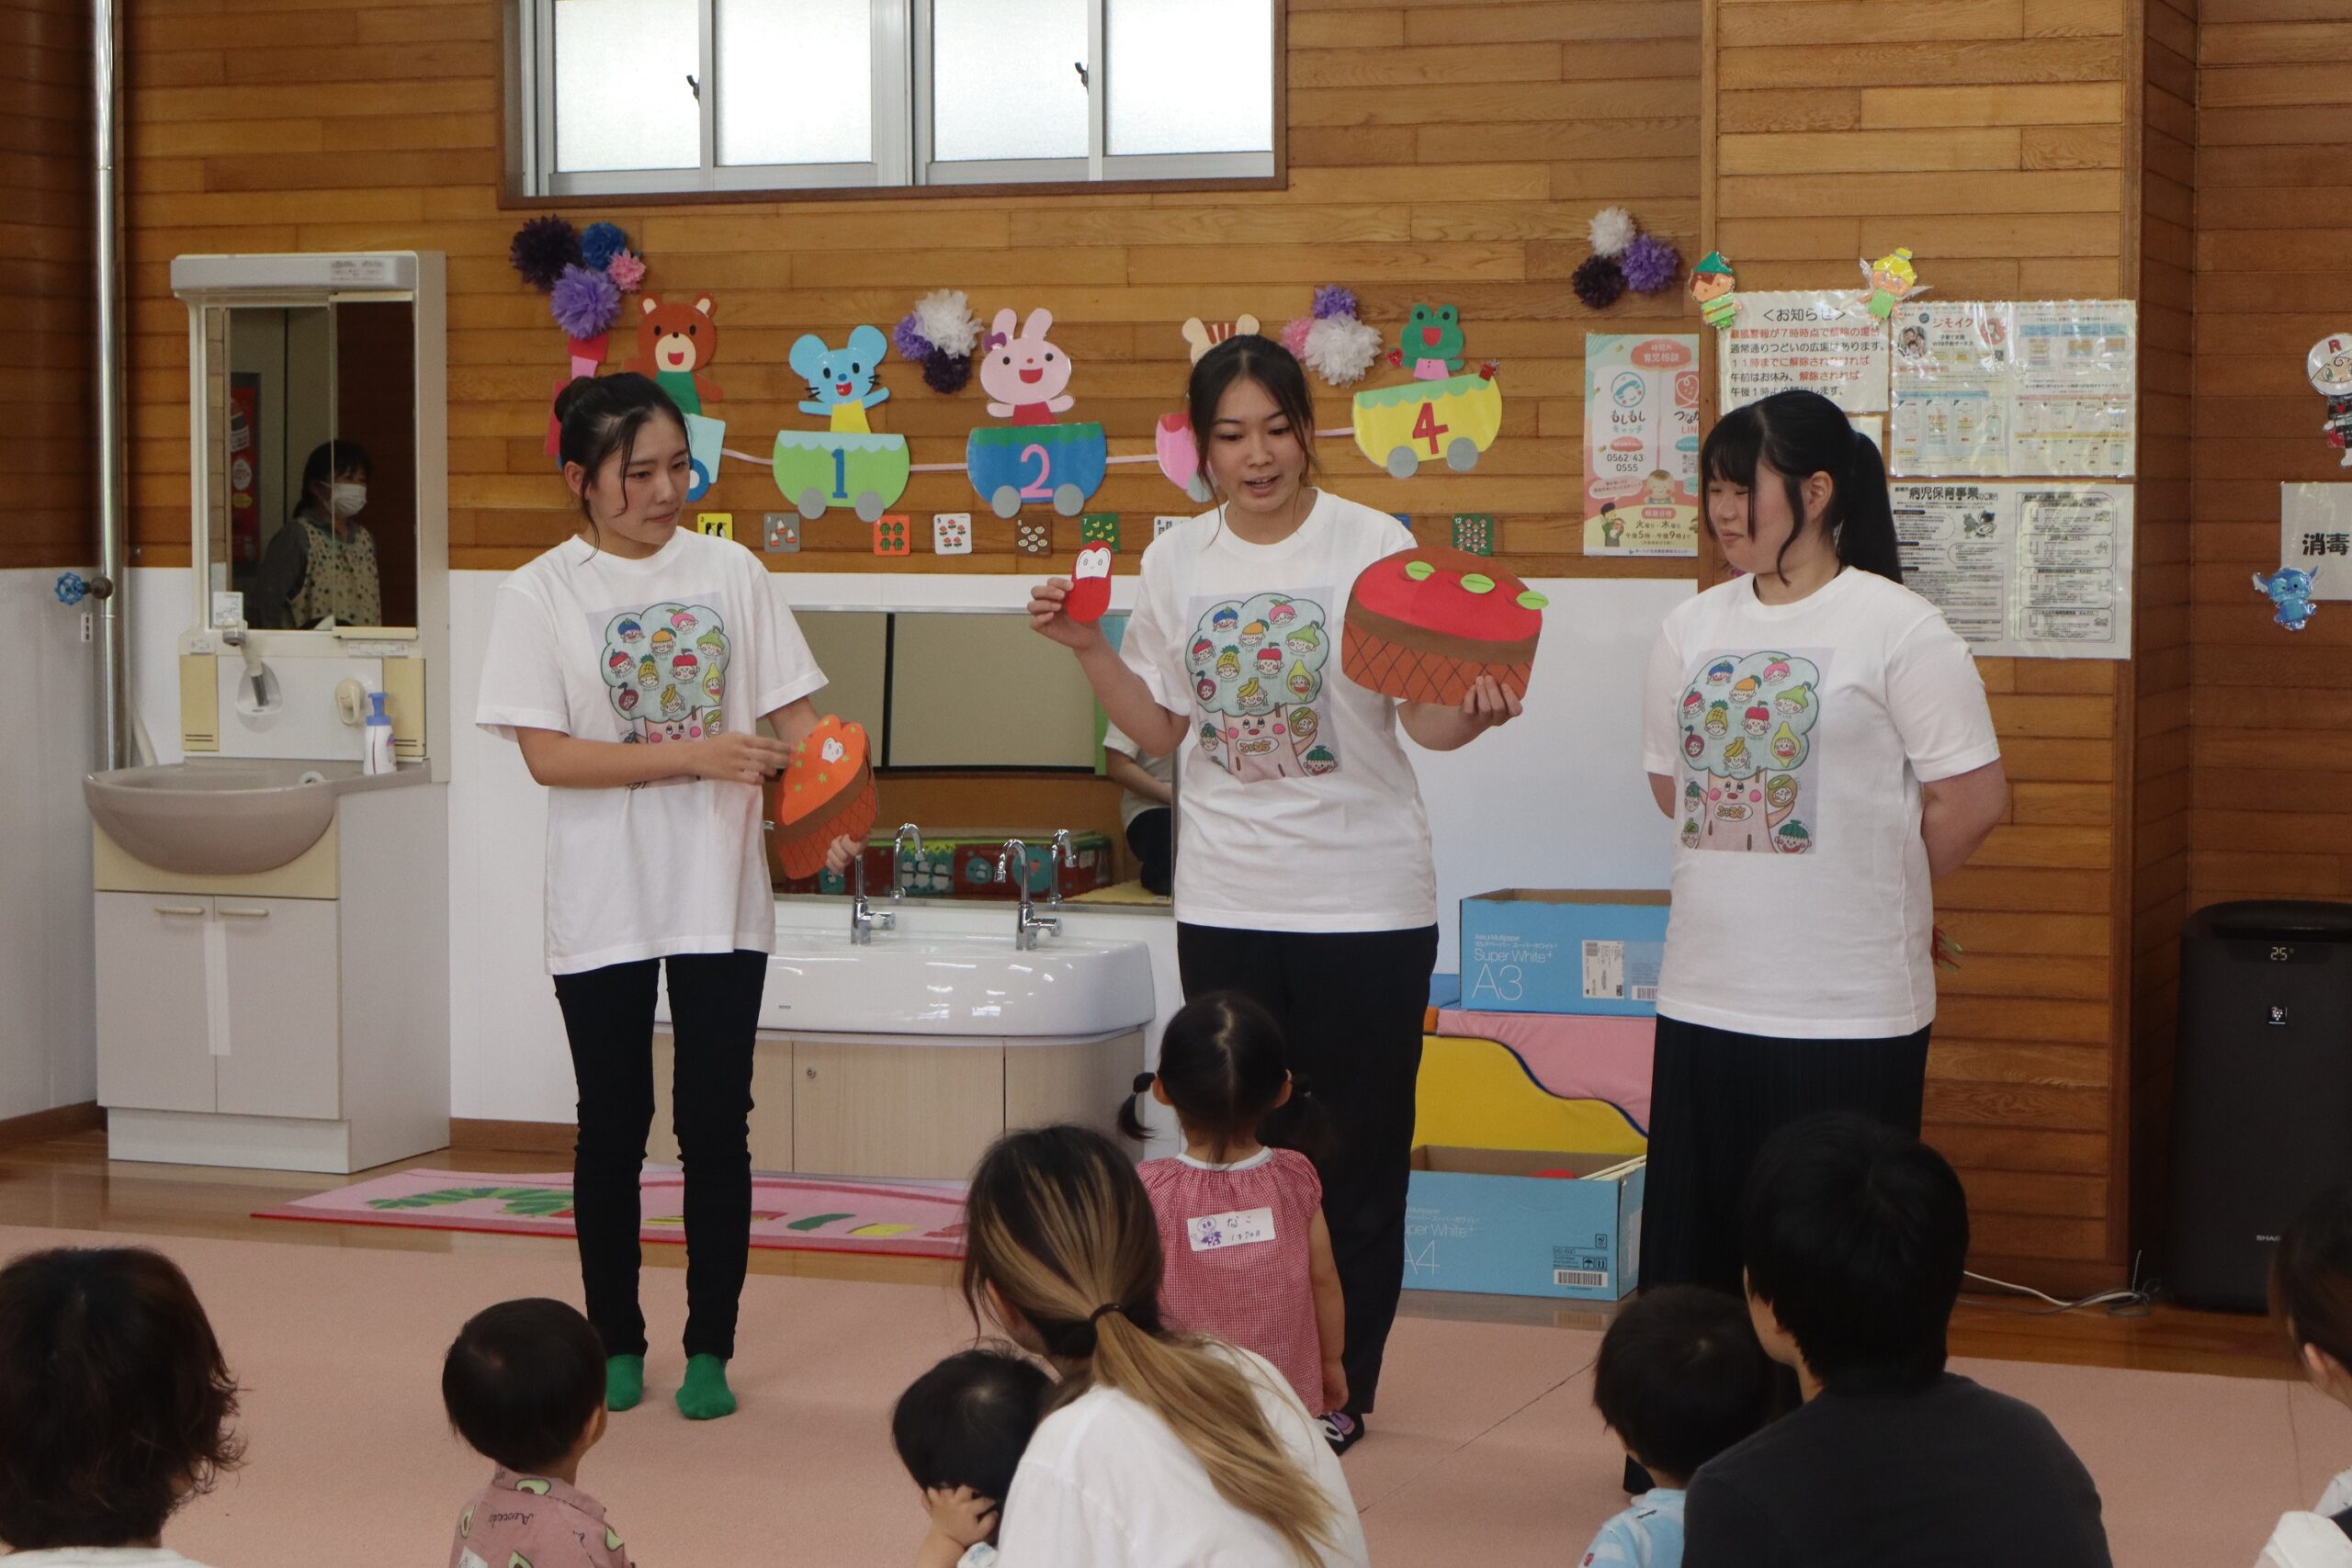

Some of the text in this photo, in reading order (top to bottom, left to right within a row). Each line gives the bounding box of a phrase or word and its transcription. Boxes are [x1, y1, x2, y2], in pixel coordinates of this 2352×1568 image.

[2328, 339, 2342, 354] R
[1611, 410, 1645, 424] もしもし
[1412, 402, 1449, 455] 4
[1681, 426, 1698, 434] LIN
[831, 446, 848, 499] 1
[1019, 444, 1053, 499] 2
[1615, 463, 1638, 472] 0555
[2301, 533, 2350, 556] 消毒
[1474, 947, 1510, 963] Super
[2270, 946, 2288, 961] 25
[1471, 964, 1523, 1001] A3
